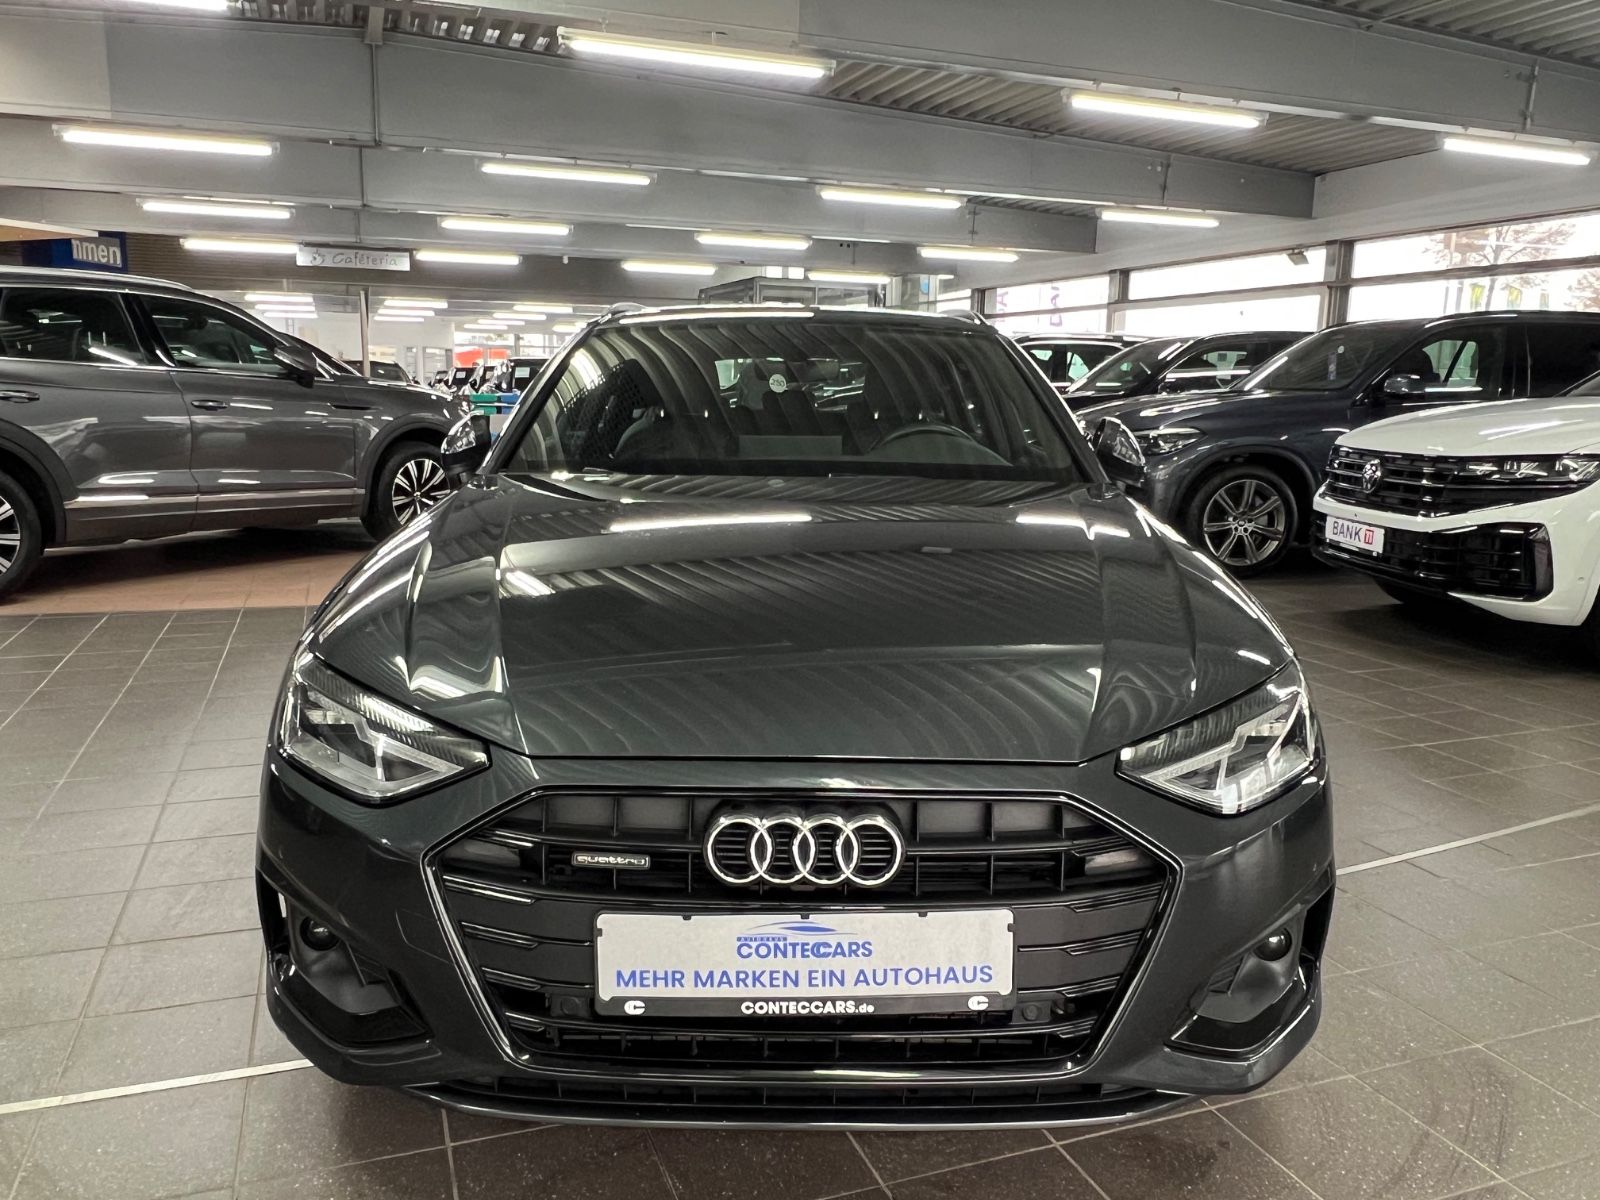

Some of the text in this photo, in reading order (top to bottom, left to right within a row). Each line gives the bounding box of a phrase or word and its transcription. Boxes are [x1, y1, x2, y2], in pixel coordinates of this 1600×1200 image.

[1332, 521, 1363, 542] BANK
[576, 856, 645, 866] quattro
[616, 965, 993, 988] MEHR MARKEN EIN AUTOHAUS
[741, 1000, 875, 1015] CONTECCARS.de
